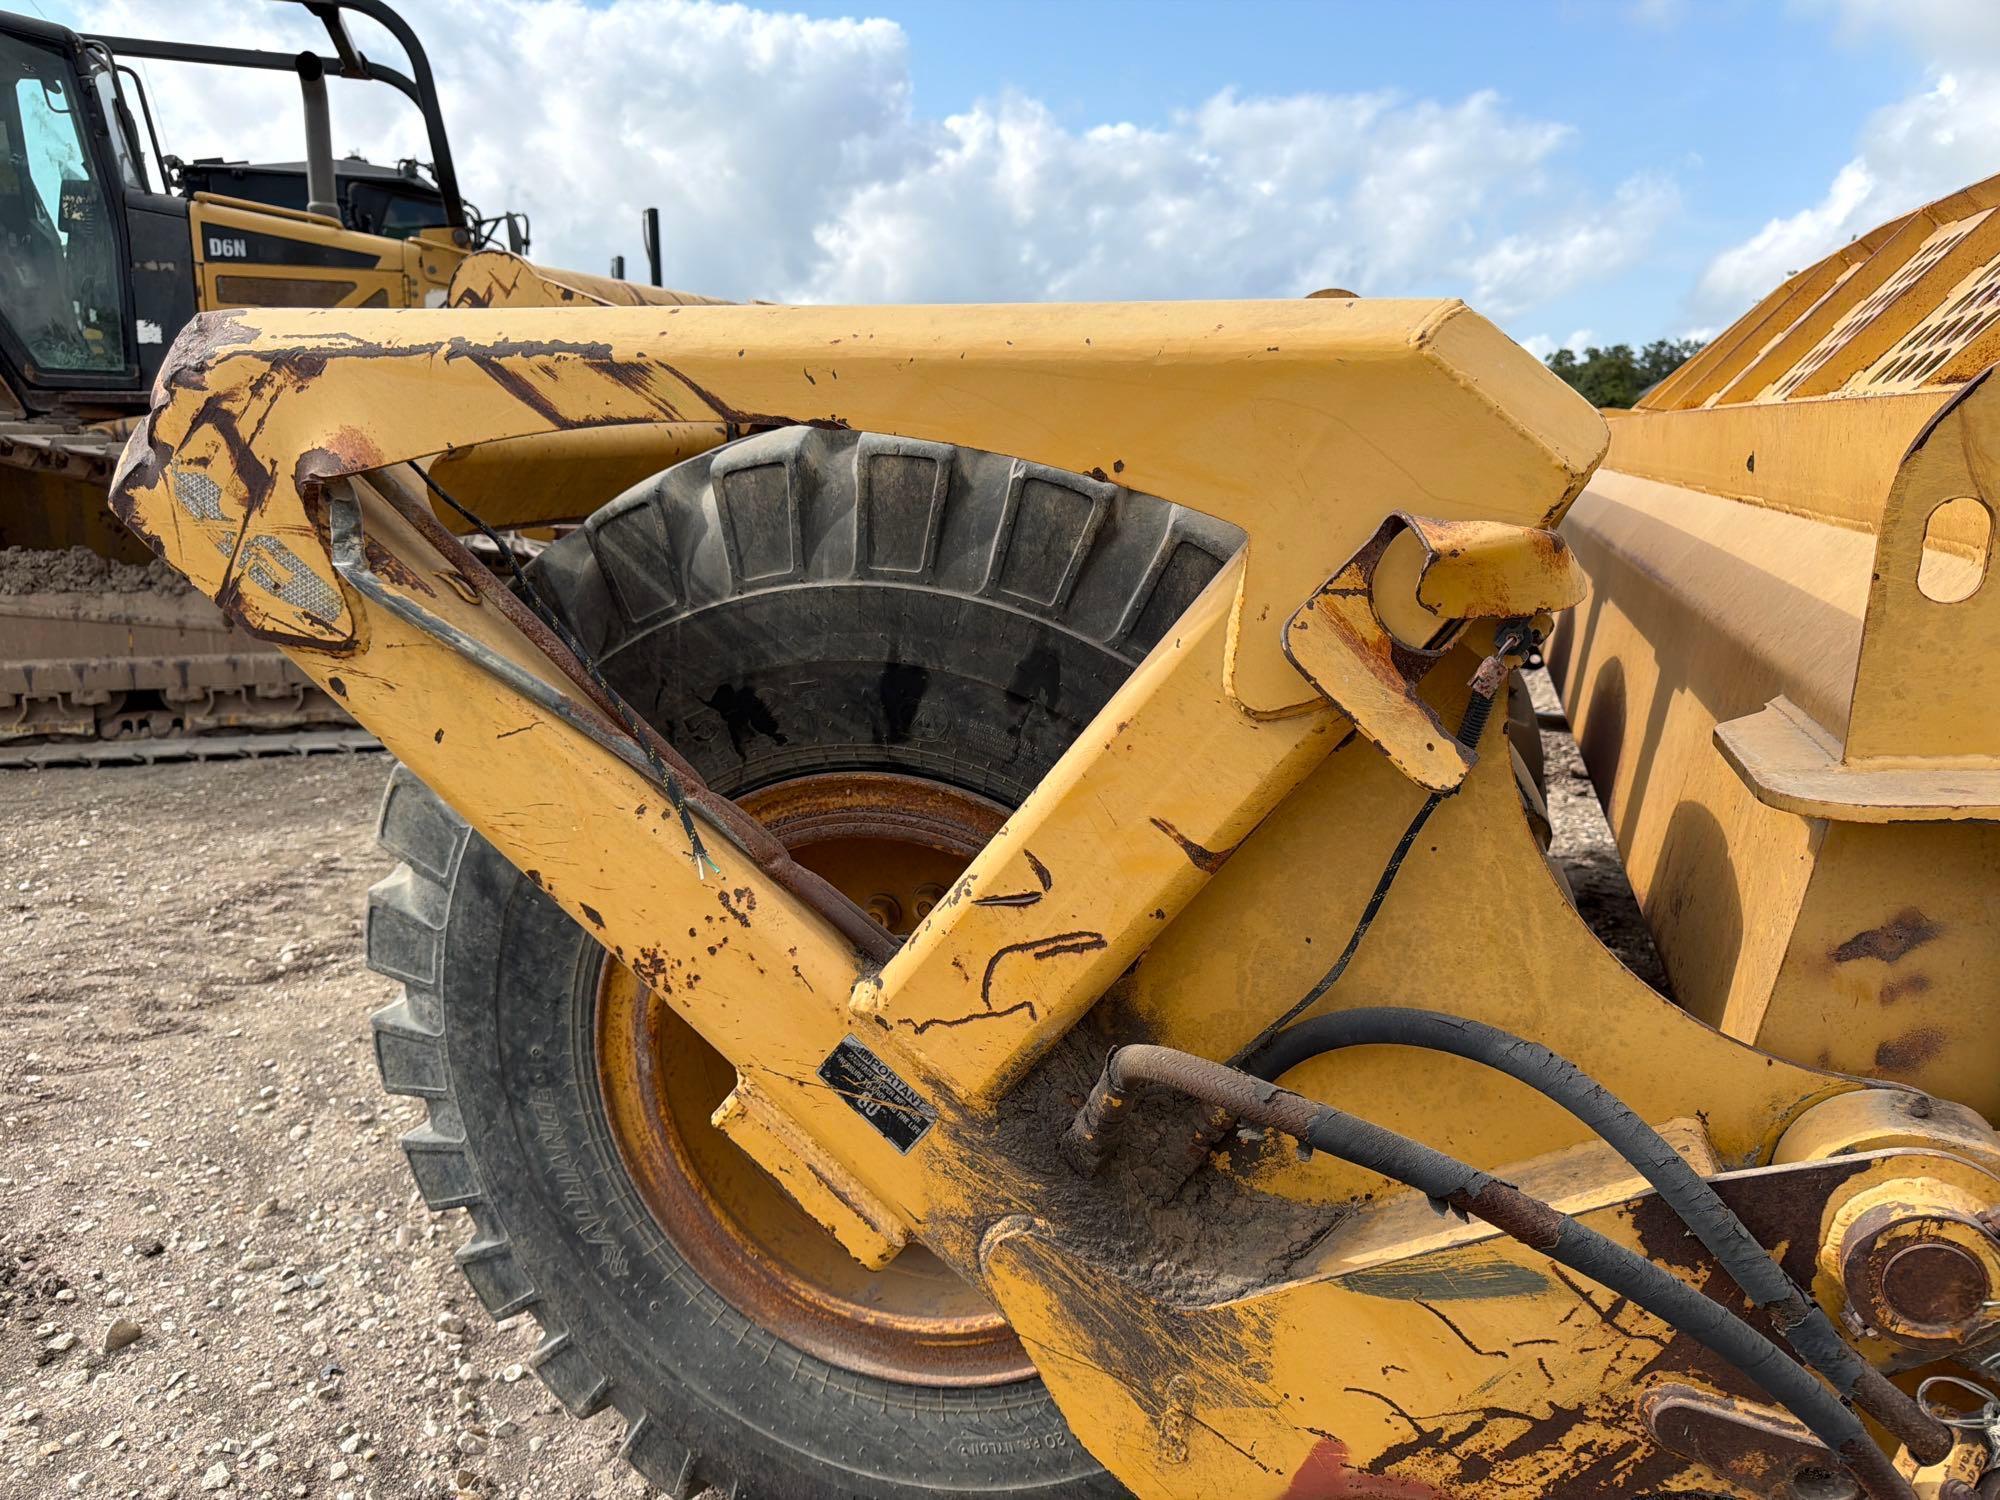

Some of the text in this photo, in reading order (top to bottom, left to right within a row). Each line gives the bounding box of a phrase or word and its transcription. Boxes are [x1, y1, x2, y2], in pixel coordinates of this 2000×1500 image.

[209, 238, 246, 257] D6N
[857, 1047, 925, 1108] IMPORTANT
[896, 1110, 910, 1124] TIRE
[908, 1120, 921, 1134] LIFE
[529, 1085, 617, 1243] ALLIANCE
[1043, 1431, 1066, 1449] 20
